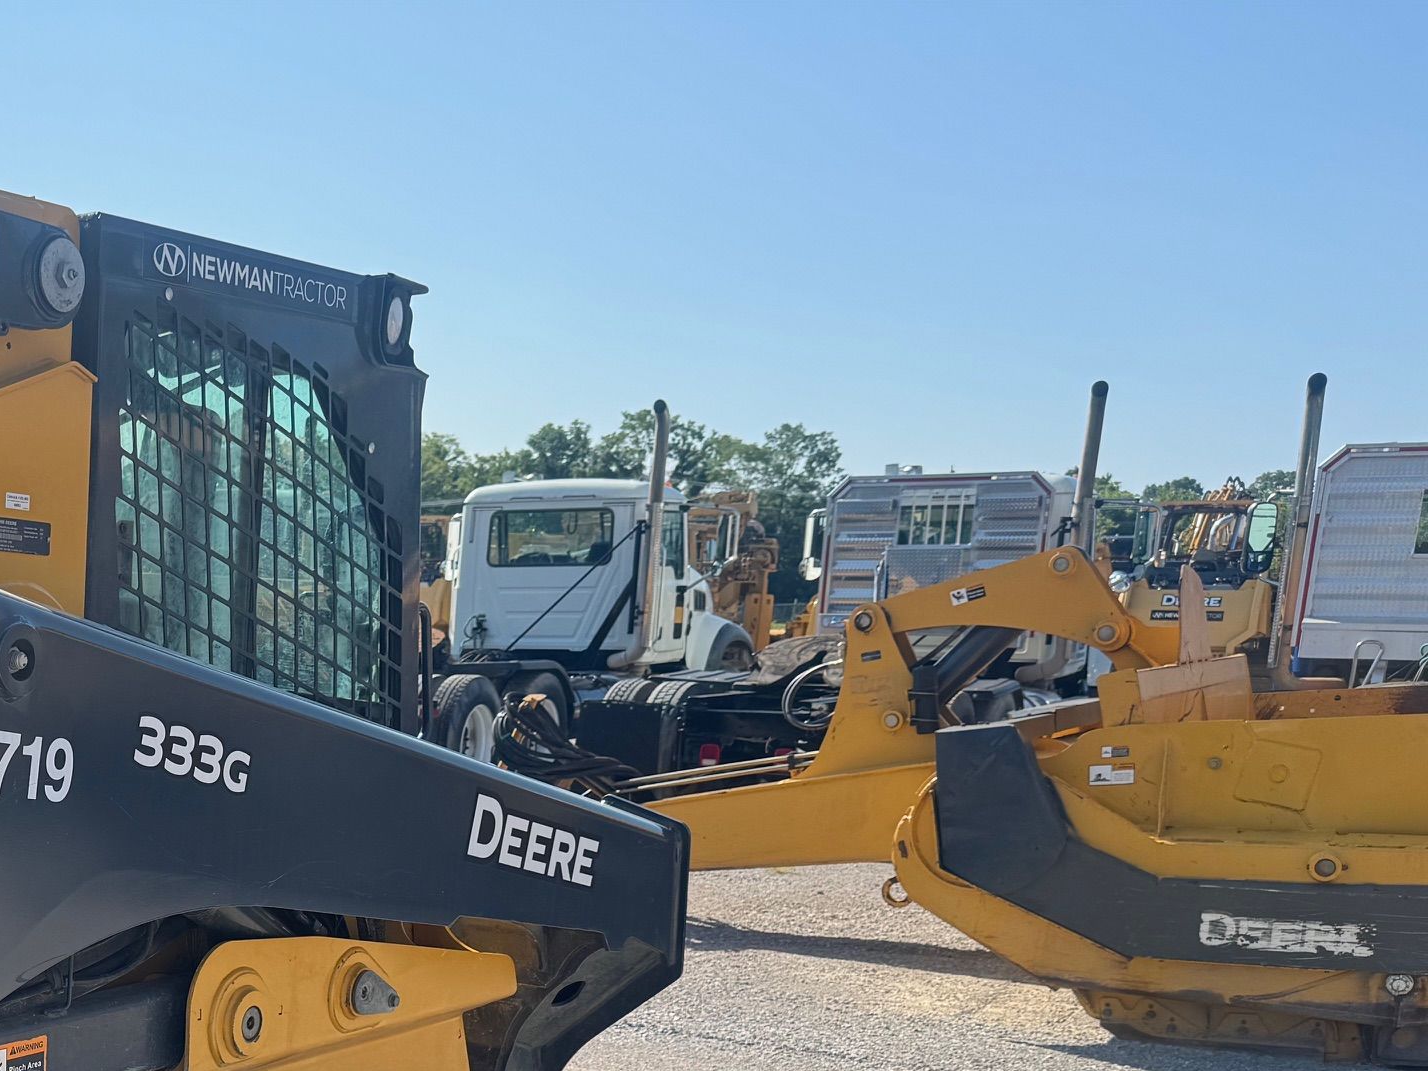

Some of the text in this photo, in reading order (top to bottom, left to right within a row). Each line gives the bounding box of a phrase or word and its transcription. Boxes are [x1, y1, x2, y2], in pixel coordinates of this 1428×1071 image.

[1162, 594, 1222, 607] DRE
[134, 715, 251, 794] 333G
[467, 793, 600, 887] DEERE
[16, 1040, 44, 1054] WARNING
[27, 1060, 42, 1070] Area
